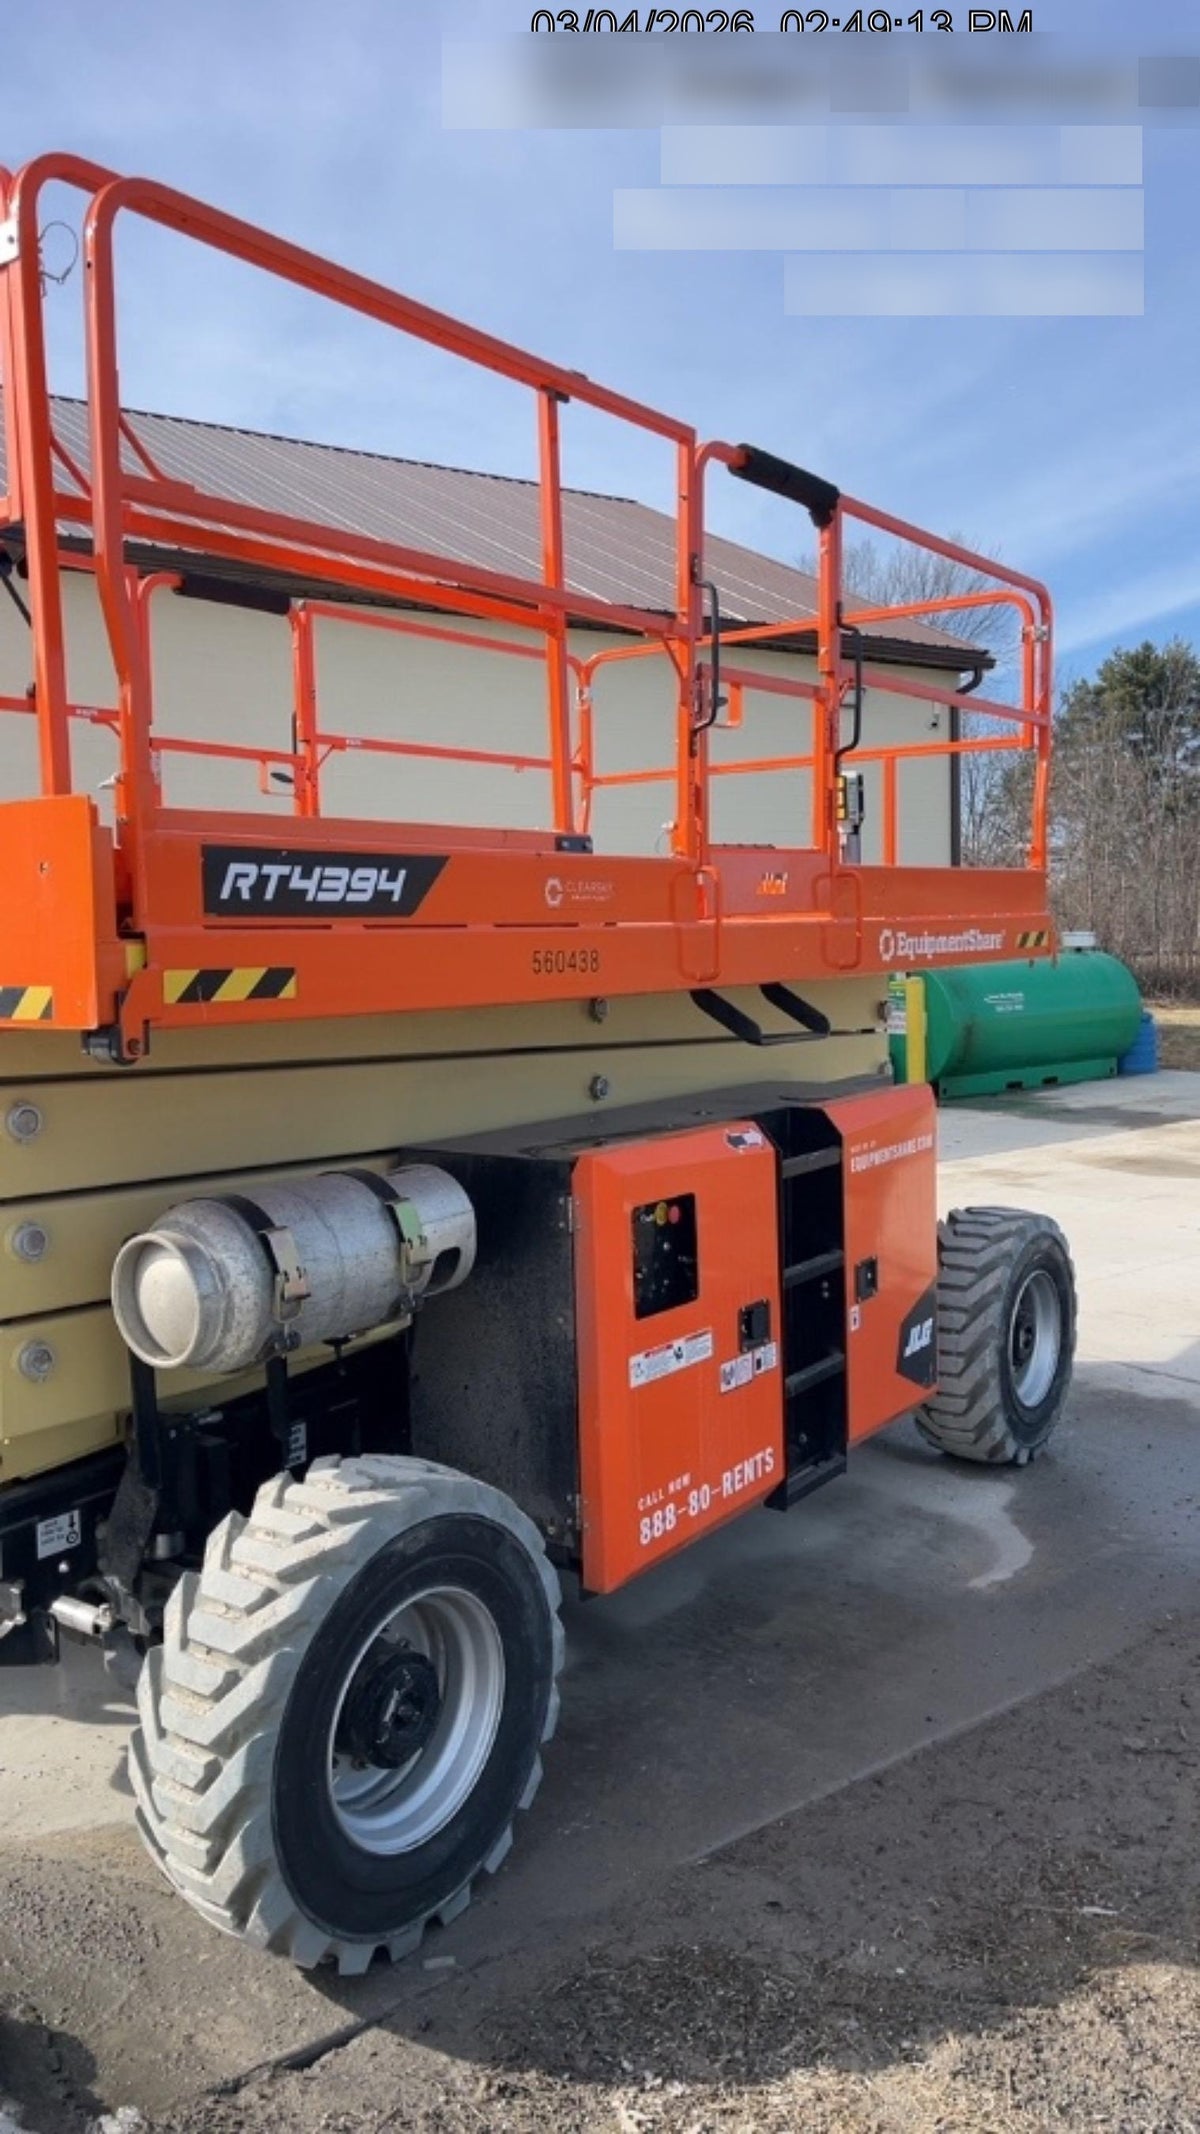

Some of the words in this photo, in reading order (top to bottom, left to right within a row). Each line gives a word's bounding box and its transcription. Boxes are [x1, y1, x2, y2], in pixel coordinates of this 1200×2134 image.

[219, 862, 407, 902] RT4394
[532, 950, 600, 974] 560438
[896, 929, 1005, 960] EquipmentShare
[903, 1317, 933, 1358] JLG
[637, 1488, 665, 1511] CALL
[639, 1446, 775, 1545] 888-80-RENTS
